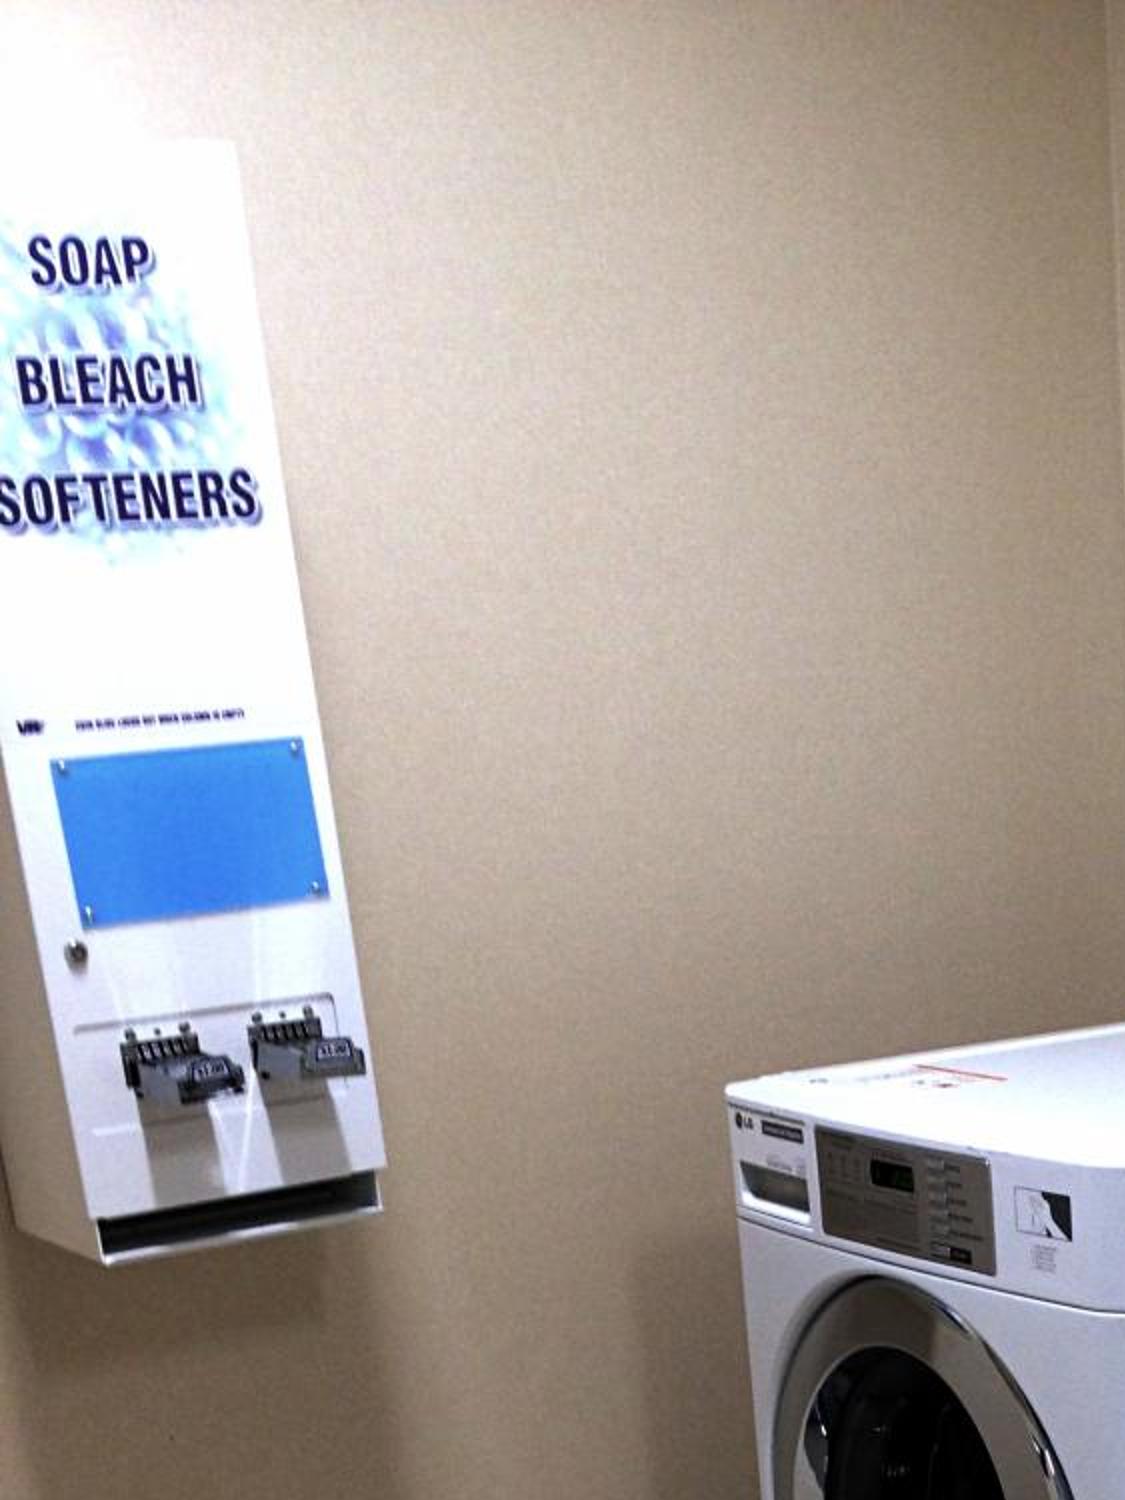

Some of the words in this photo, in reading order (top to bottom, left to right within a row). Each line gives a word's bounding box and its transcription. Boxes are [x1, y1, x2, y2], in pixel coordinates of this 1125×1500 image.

[28, 234, 153, 289] SOAP
[15, 353, 202, 409] BLEACH
[0, 469, 260, 531] SOFTENERS
